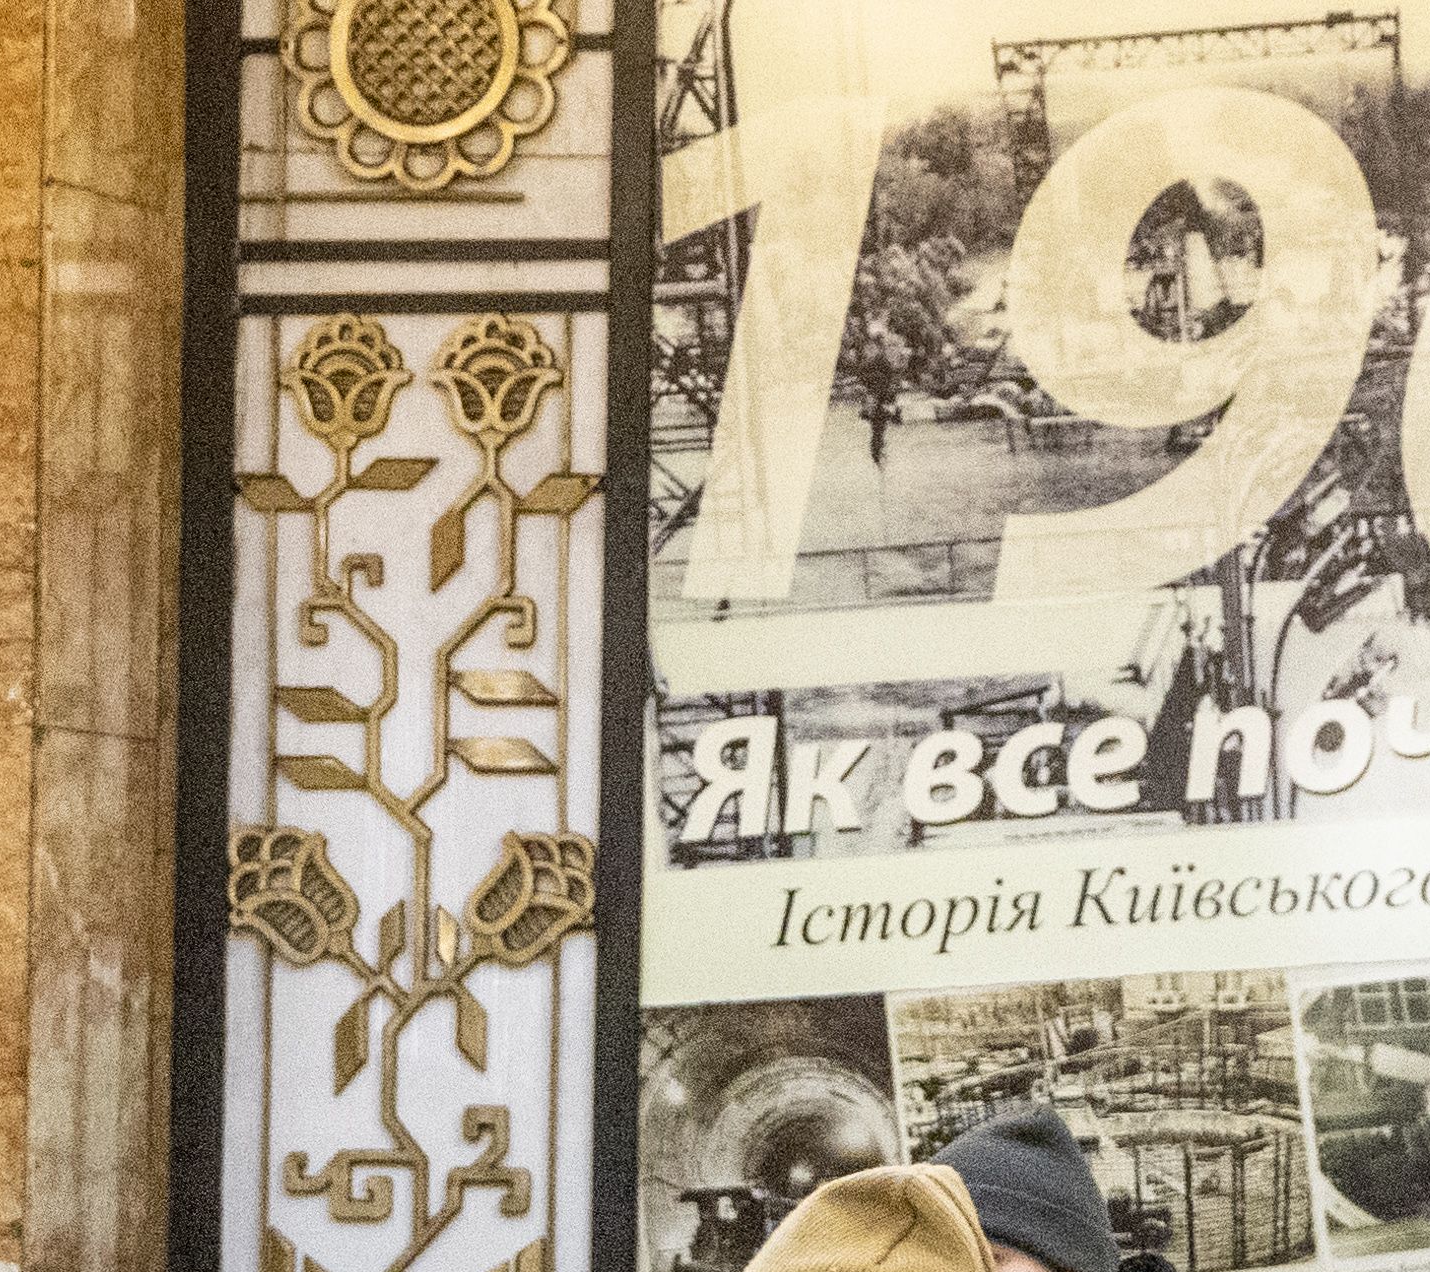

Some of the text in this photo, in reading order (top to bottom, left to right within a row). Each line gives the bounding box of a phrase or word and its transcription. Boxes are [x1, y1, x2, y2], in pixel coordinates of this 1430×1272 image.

[677, 713, 872, 845] Як
[902, 714, 1150, 827] все
[769, 875, 1047, 956] Історія
